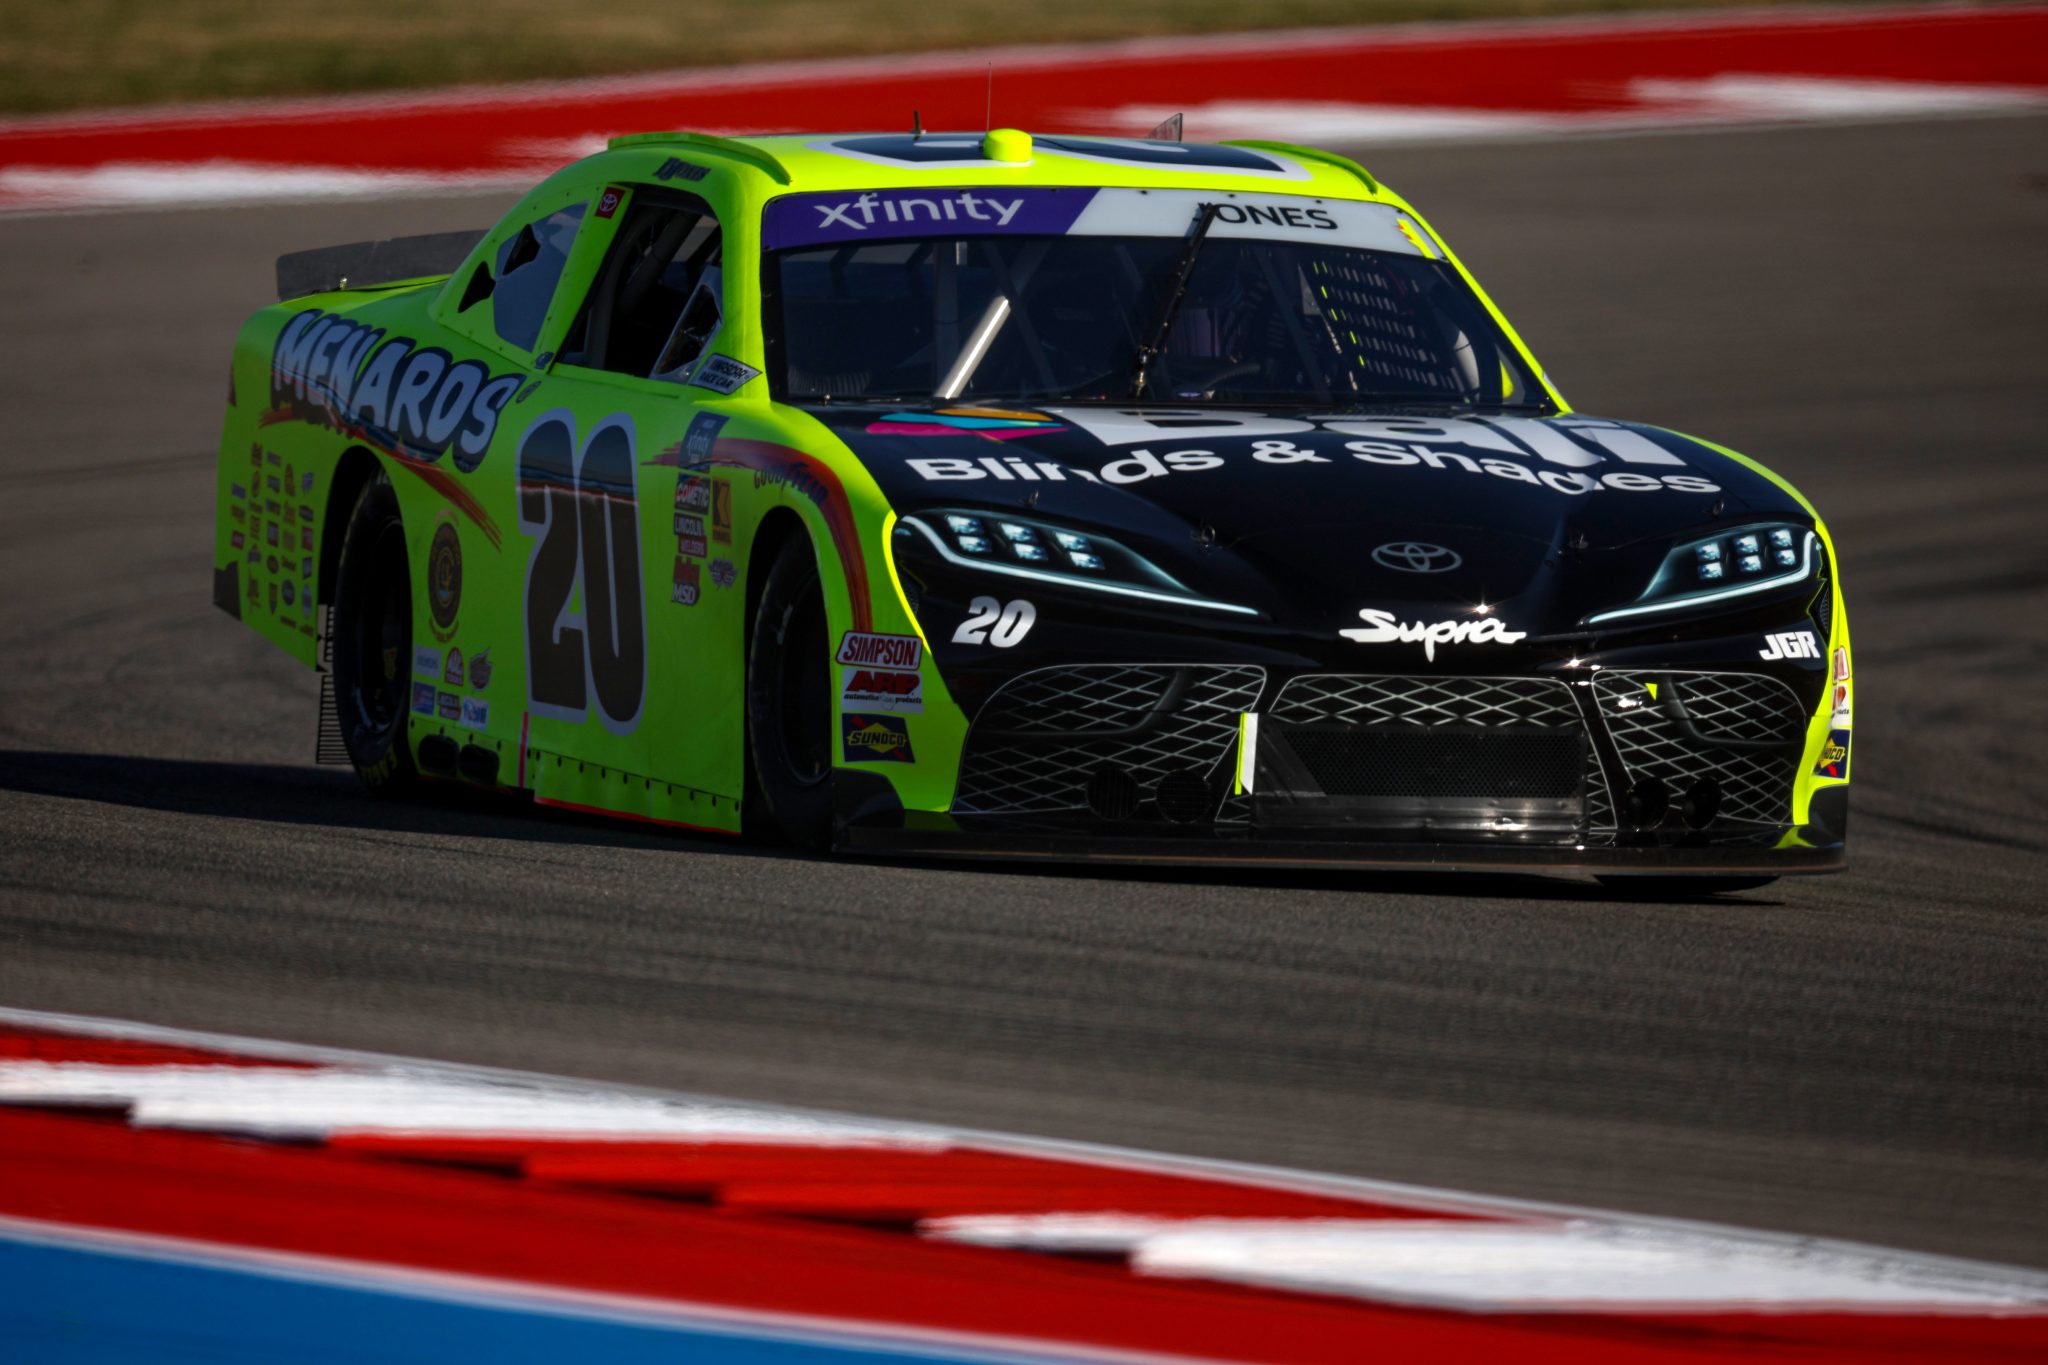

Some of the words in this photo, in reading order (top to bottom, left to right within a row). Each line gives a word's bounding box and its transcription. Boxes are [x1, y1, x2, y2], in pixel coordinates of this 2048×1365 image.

[812, 193, 1026, 232] xfinity
[271, 309, 525, 466] MENARDS
[905, 447, 1225, 485] Blinds
[1250, 440, 1332, 464] &
[1344, 440, 1722, 495] Shades
[516, 407, 642, 736] 20
[951, 595, 1037, 648] 20
[1338, 608, 1527, 663] Supra
[843, 635, 918, 666] SIMPSON
[1758, 631, 1821, 661] JGR
[846, 671, 919, 694] ARP
[850, 730, 905, 747] SUNOCO
